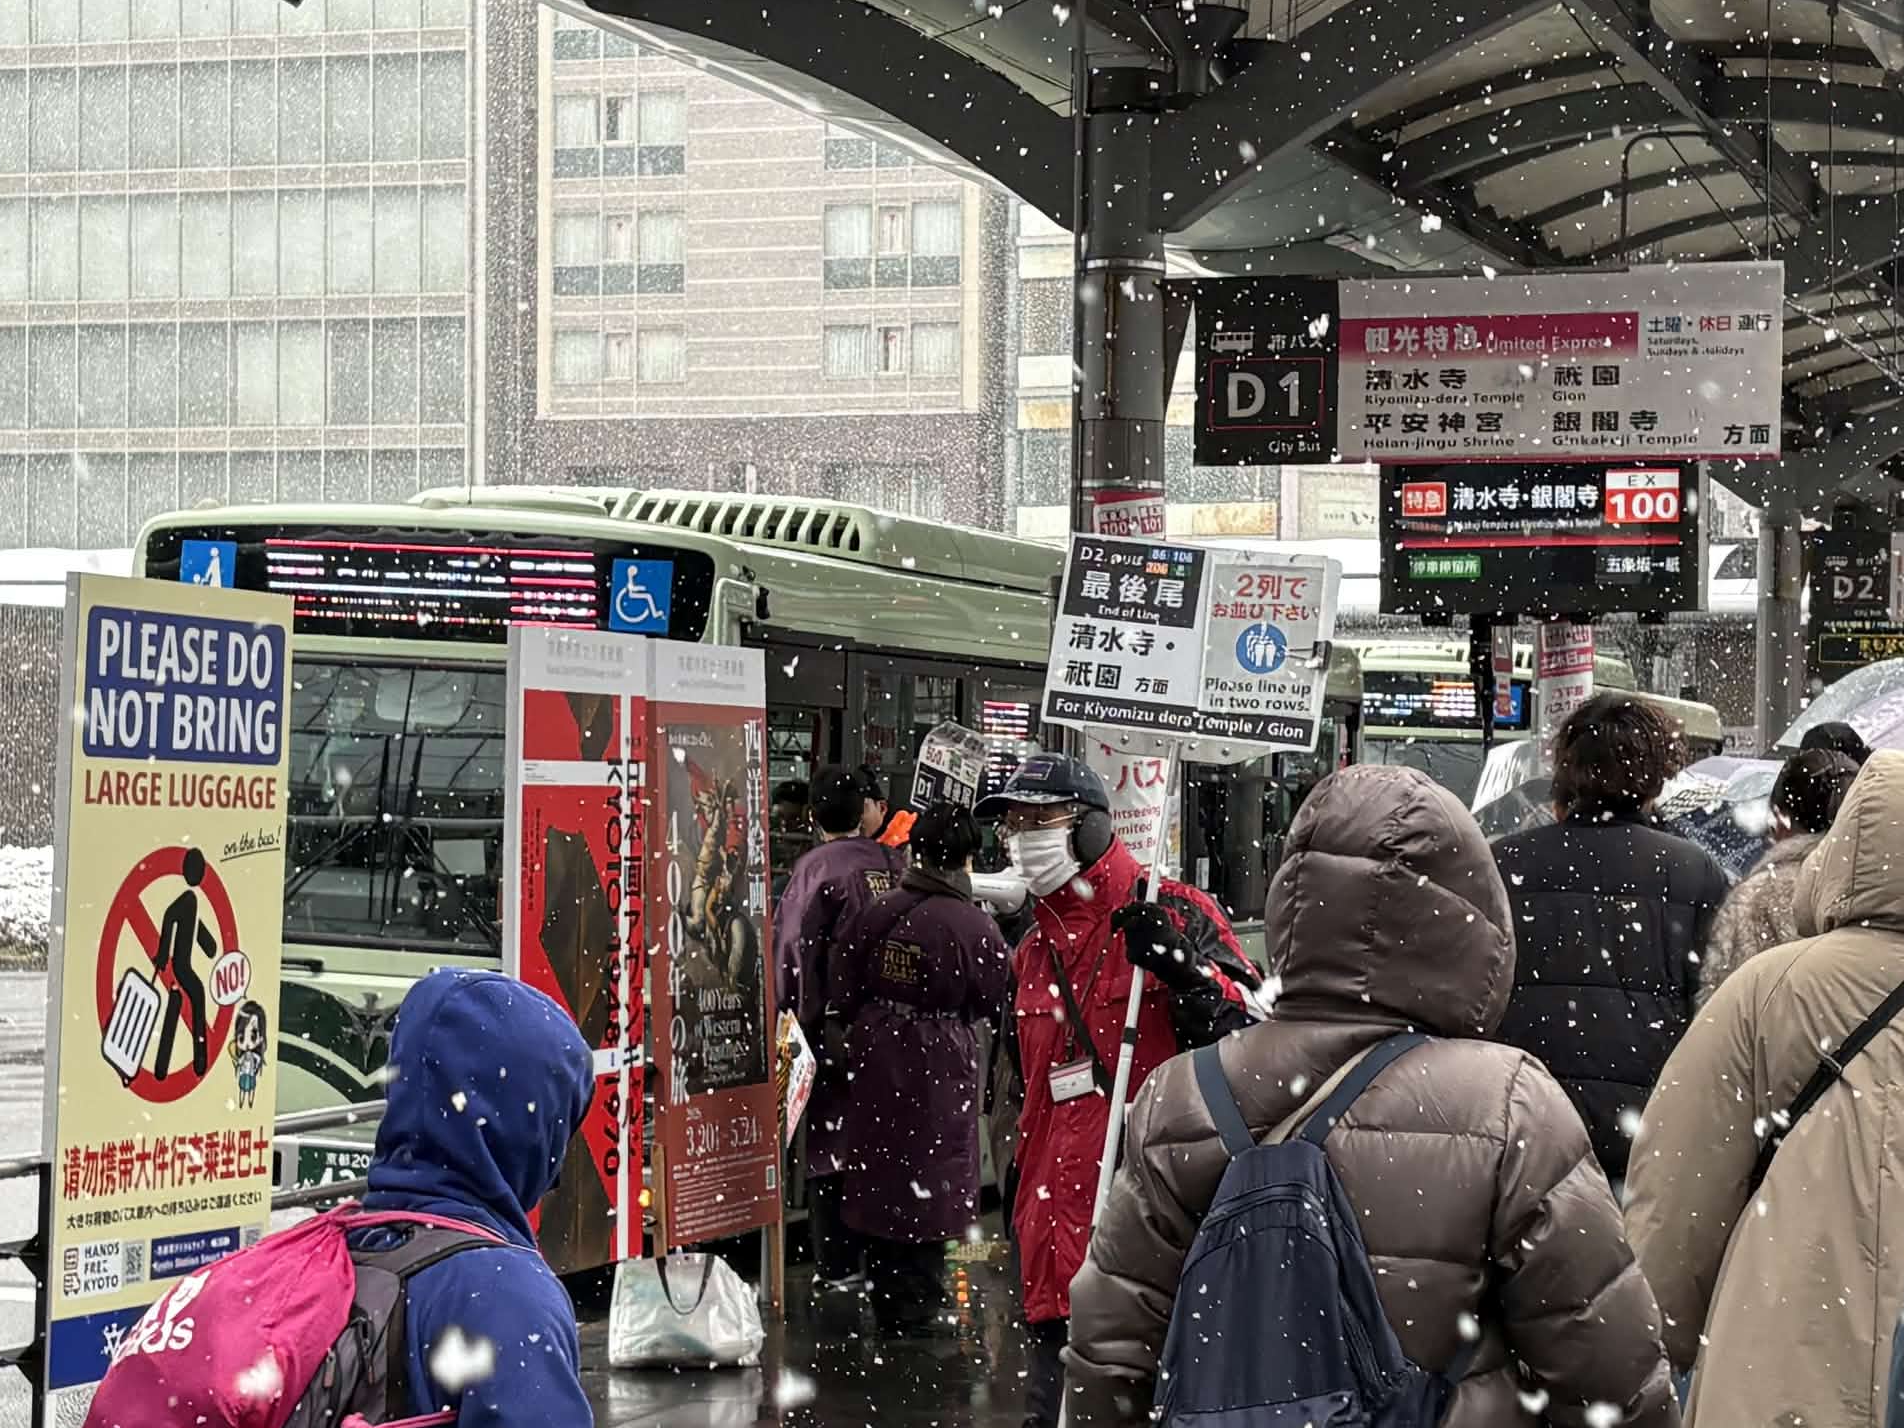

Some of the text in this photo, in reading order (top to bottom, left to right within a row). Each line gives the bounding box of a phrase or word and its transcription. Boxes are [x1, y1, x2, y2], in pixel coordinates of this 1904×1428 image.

[1365, 323, 1478, 353] 観光特急
[1486, 336, 1545, 351] Limited
[1366, 369, 1467, 391] 清水寺
[1553, 365, 1621, 387] 祇園
[1227, 371, 1300, 419] D1
[1364, 392, 1526, 407] Kiyomizu-dera Temple
[1552, 390, 1586, 402] Gion
[1364, 412, 1504, 435] 平安神宮
[1552, 410, 1659, 433] 銀閣寺
[1364, 436, 1515, 450] Heian-jingu Shrine
[1638, 434, 1698, 447] Temple
[1723, 423, 1772, 445] 方面
[1268, 440, 1321, 455] City Bus
[1628, 474, 1657, 487] EX
[1405, 482, 1600, 510] 特急 清水寺・銀閣寺
[1608, 493, 1679, 521] 100
[1080, 570, 1186, 609] 最後尾
[1235, 574, 1308, 600] 2列で
[1833, 575, 1875, 599] D2
[1098, 604, 1161, 621] End of Line
[1211, 601, 1320, 621] お並び下さい
[99, 618, 273, 690] PLEASE DO
[1064, 660, 1170, 695] 祇園 方面
[1205, 678, 1312, 698] Please line up
[1209, 693, 1226, 707] in
[1229, 696, 1260, 709] two
[88, 687, 277, 755] NOT BRING
[1055, 698, 1304, 739] For Kiyomizu dera Temple Gion
[1114, 759, 1165, 793] バス
[84, 769, 277, 810] LARGE LUGGAGE
[223, 839, 239, 856] on
[257, 824, 281, 848] bus!
[606, 758, 623, 911] KYOTO
[214, 962, 246, 996] NO!
[83, 1274, 119, 1293] KYOTO
